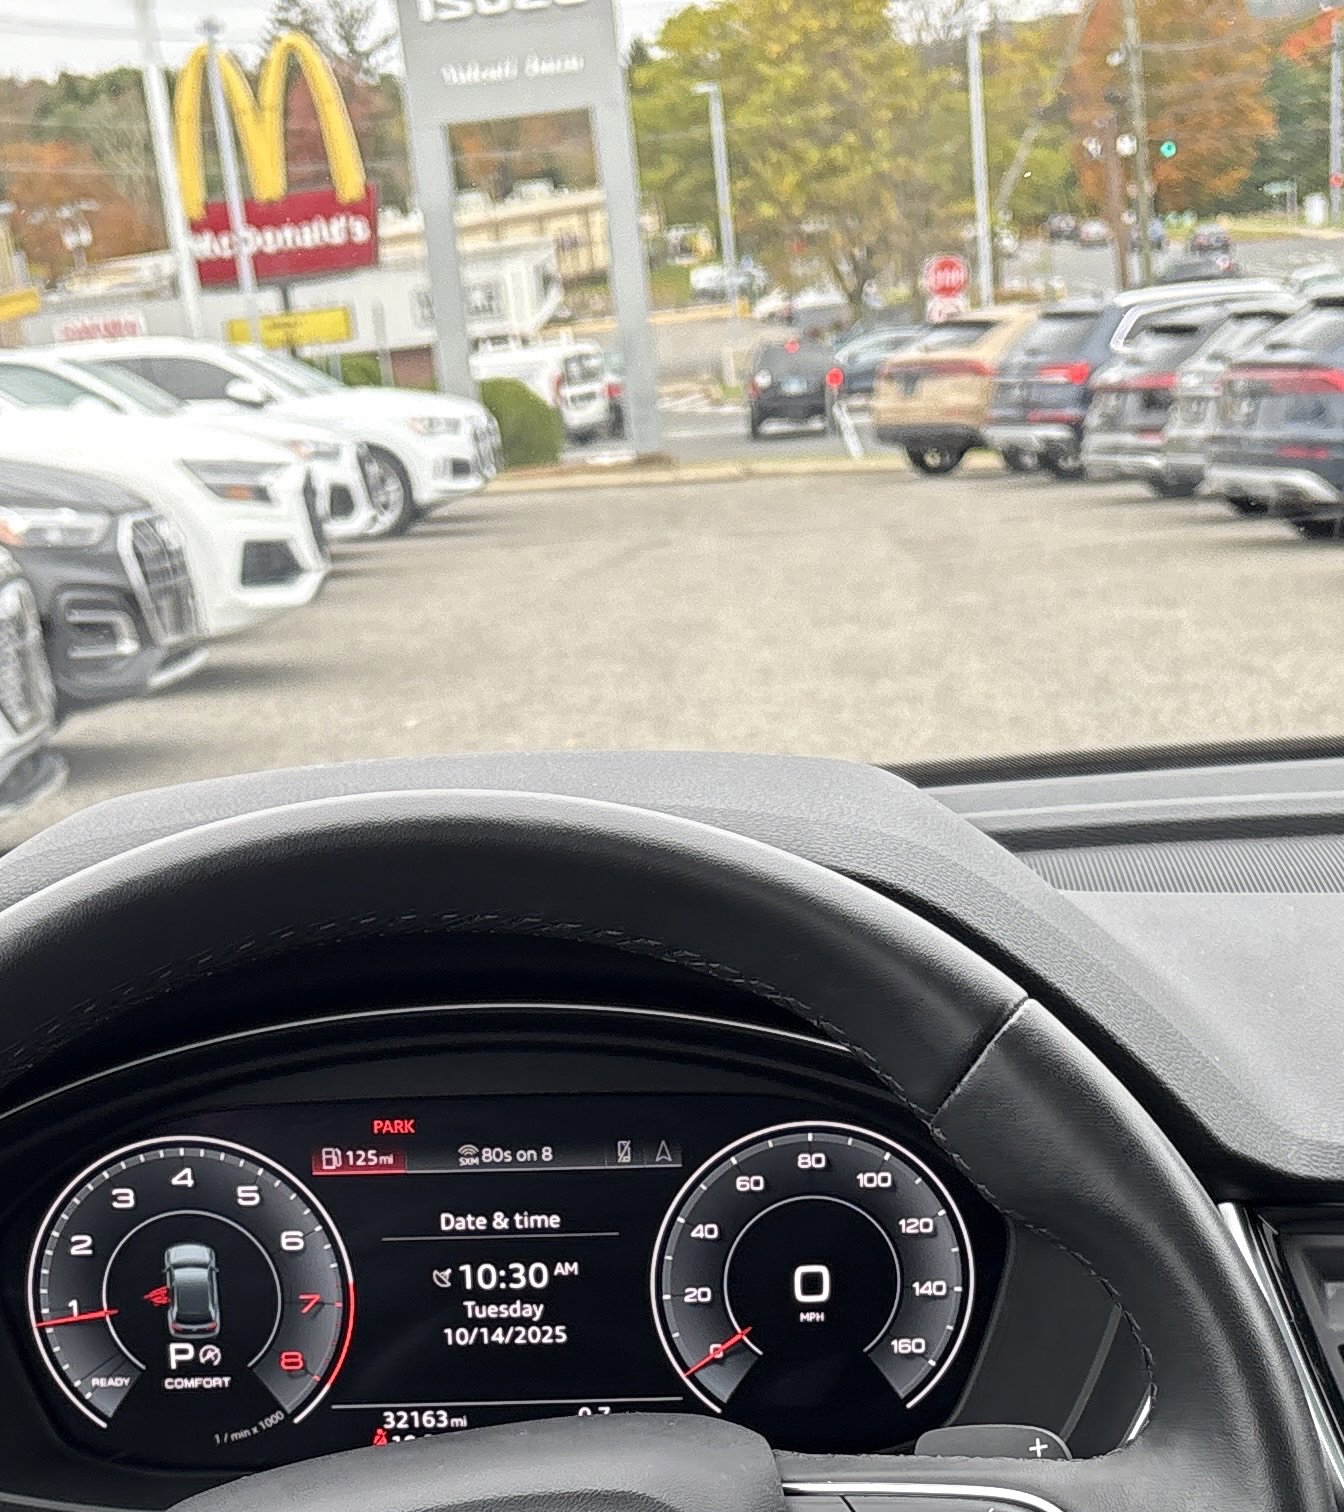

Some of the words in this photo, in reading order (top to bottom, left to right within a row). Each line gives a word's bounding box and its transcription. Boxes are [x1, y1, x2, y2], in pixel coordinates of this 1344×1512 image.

[374, 1120, 414, 1133] PARK
[459, 1157, 479, 1166] SXM
[482, 1148, 512, 1162] 80s
[516, 1150, 537, 1161] on
[542, 1147, 552, 1161] 8
[798, 1153, 825, 1168] 80
[172, 1168, 194, 1187] 4
[736, 1176, 764, 1191] 60
[857, 1172, 891, 1187] 100
[112, 1188, 134, 1208] 3
[237, 1186, 260, 1205] 5
[441, 1213, 487, 1230] Date
[492, 1212, 509, 1229] &
[514, 1211, 560, 1229] time
[899, 1218, 933, 1233] 120
[691, 1224, 718, 1238] 40
[70, 1235, 92, 1255] 2
[281, 1231, 304, 1250] 6
[459, 1263, 548, 1289] 10:30
[554, 1262, 578, 1275] AM
[794, 1265, 829, 1302] 0
[684, 1288, 711, 1302] 20
[913, 1280, 946, 1296] 140
[67, 1299, 79, 1317] 1
[299, 1294, 320, 1313] 7
[463, 1300, 544, 1321] Tuesday
[800, 1312, 824, 1322] MPH
[444, 1326, 567, 1345] 10/14/2025
[891, 1338, 925, 1353] 160
[169, 1343, 194, 1369] P
[281, 1352, 303, 1369] 8
[92, 1378, 129, 1387] READY
[165, 1377, 231, 1389] COMFORT
